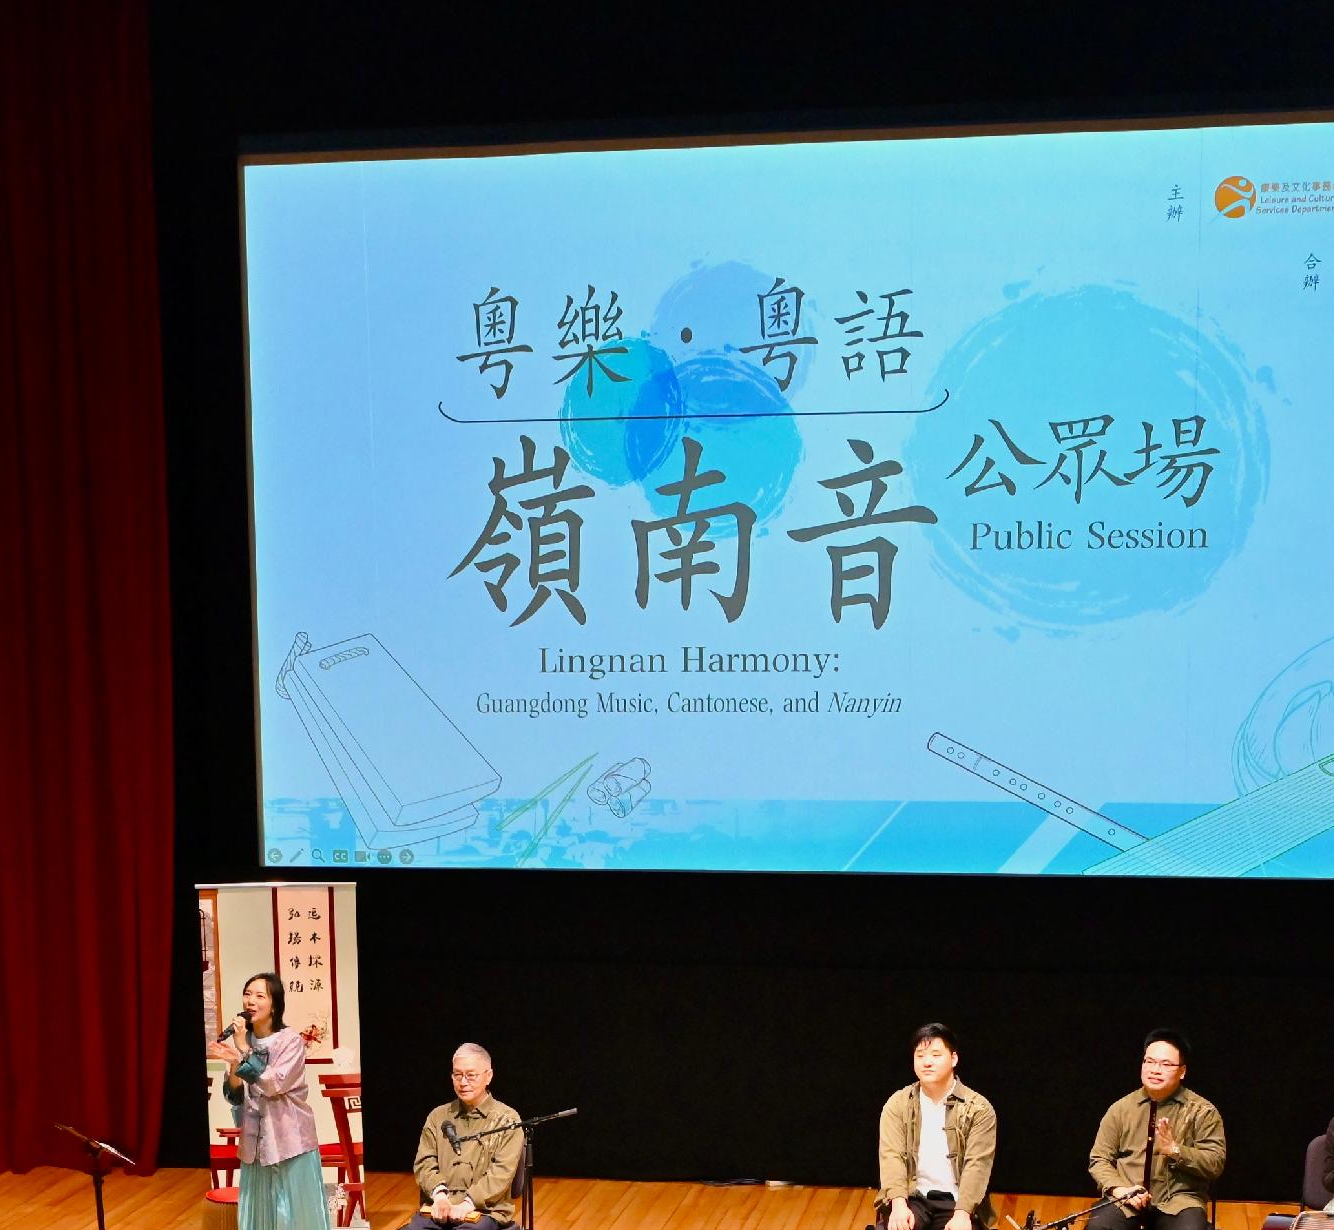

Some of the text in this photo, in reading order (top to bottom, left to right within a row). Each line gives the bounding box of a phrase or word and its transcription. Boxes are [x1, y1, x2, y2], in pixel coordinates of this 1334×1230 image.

[1256, 206, 1289, 214] Services
[945, 415, 1220, 508] 公眾場
[447, 434, 938, 630] 嶺南音
[970, 521, 1209, 550] Public Session
[539, 647, 839, 680] Lingnan Harmony:
[477, 691, 902, 718] Guangdong Music, Cantonese, and Nanyin
